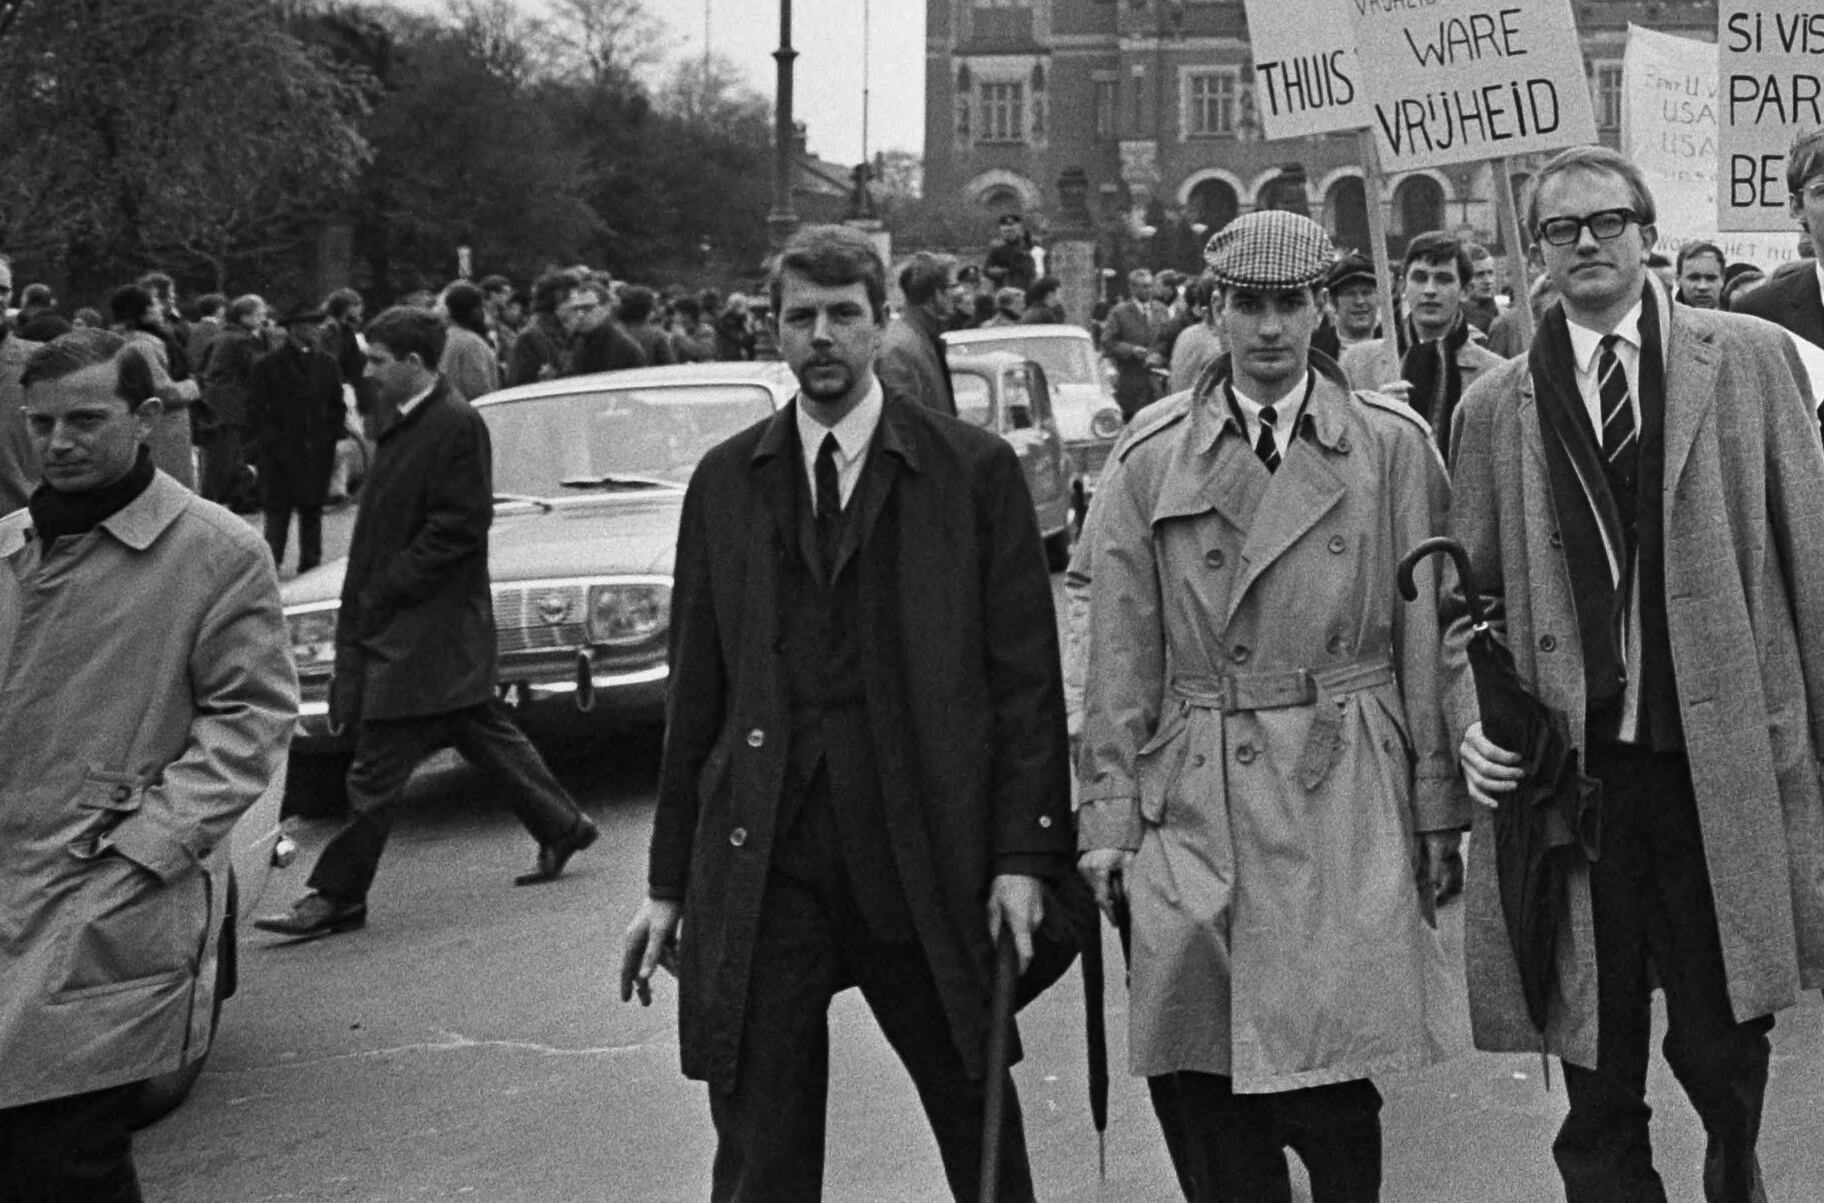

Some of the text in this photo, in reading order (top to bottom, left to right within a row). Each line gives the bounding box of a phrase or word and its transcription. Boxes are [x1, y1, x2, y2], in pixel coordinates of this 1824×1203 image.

[1404, 9, 1527, 67] WARE
[1728, 13, 1762, 53] SI
[1256, 50, 1354, 115] THUIS
[1375, 78, 1559, 156] VRIJHEID
[1663, 99, 1716, 125] USA
